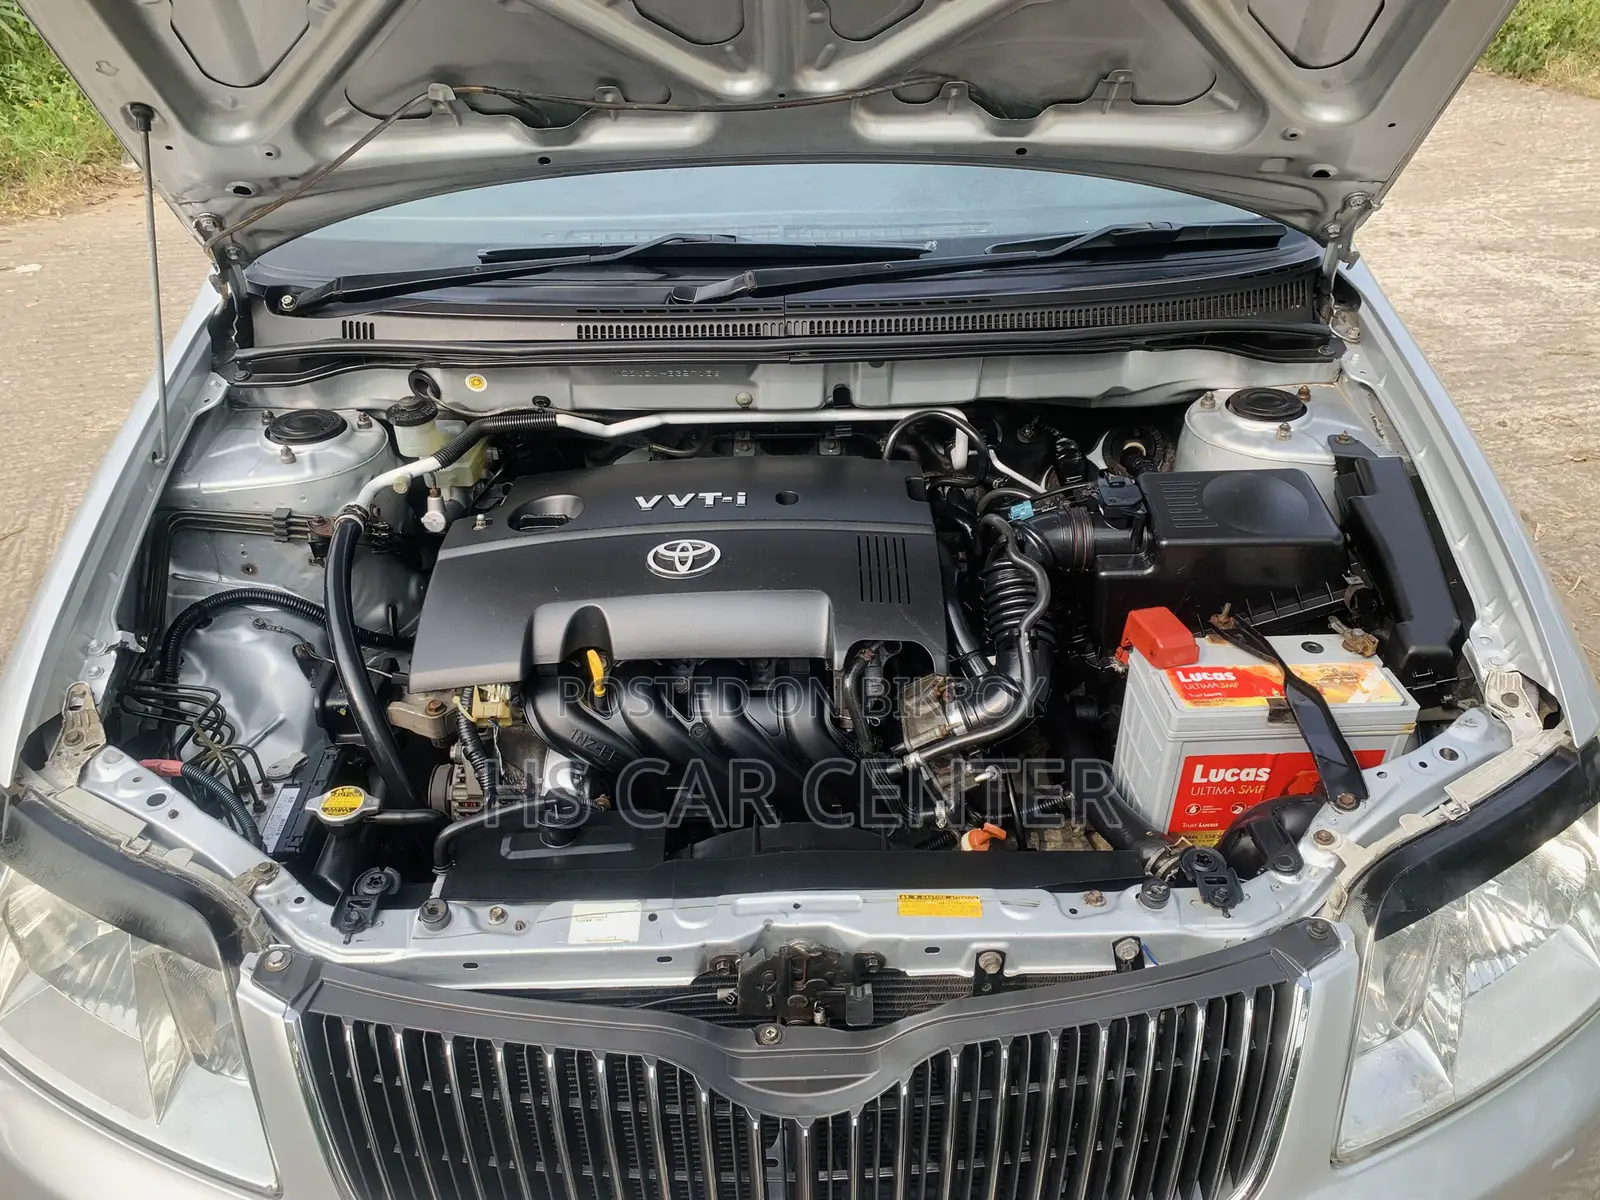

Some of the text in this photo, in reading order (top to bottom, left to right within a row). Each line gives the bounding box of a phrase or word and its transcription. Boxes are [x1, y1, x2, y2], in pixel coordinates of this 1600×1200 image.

[634, 491, 748, 511] VVT-i
[1176, 670, 1236, 683] Lucas
[1184, 681, 1239, 690] ULTIMA SMF
[1192, 764, 1272, 783] Lucas
[1190, 784, 1267, 796] ULTIMA SMF
